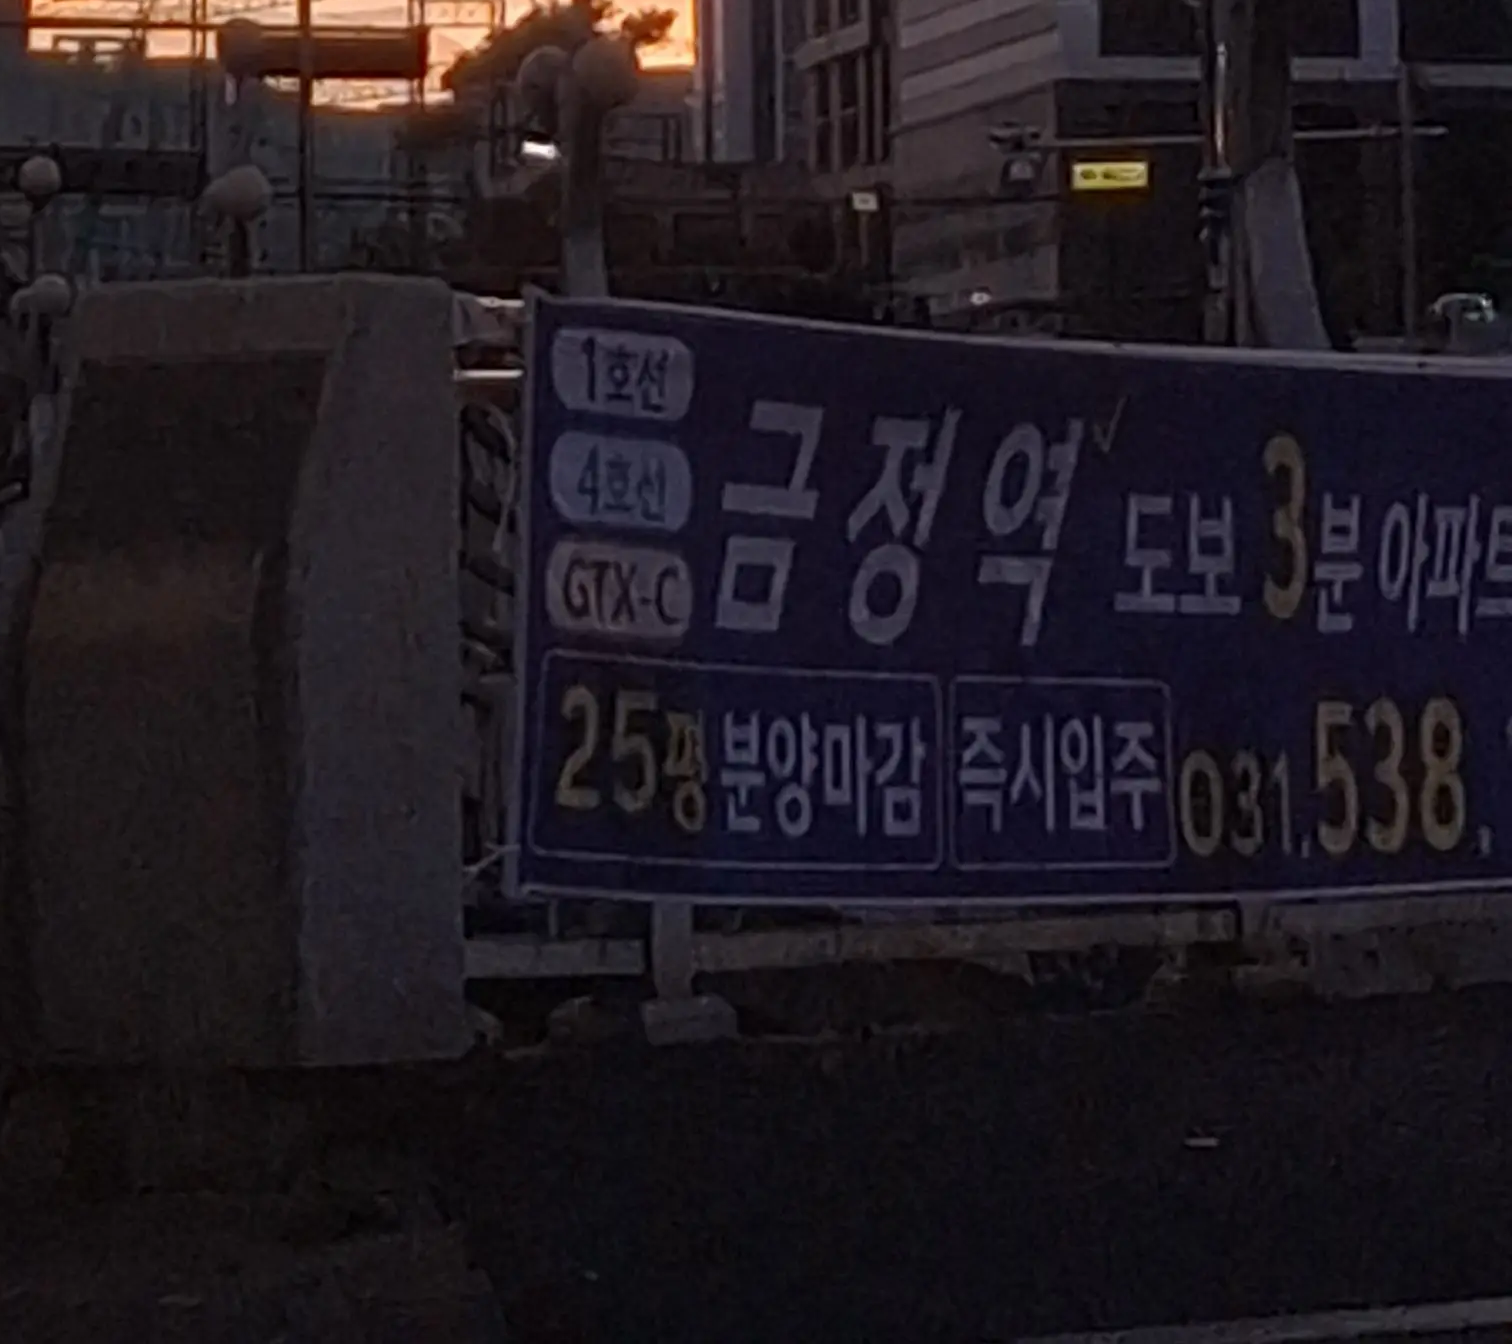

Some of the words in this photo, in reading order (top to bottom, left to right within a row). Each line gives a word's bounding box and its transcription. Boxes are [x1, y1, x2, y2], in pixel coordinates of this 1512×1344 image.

[580, 337, 670, 412] 1호선
[577, 442, 668, 523] 4호선
[714, 399, 1085, 647] 금정역
[1113, 491, 1243, 616] 도보
[1261, 429, 1366, 634] 3분
[562, 557, 680, 626] GTX-C
[554, 683, 709, 833] 25평
[720, 709, 928, 838] 분양마감
[957, 711, 1164, 834] 즉시입주
[1178, 695, 1512, 859] 031.538.
